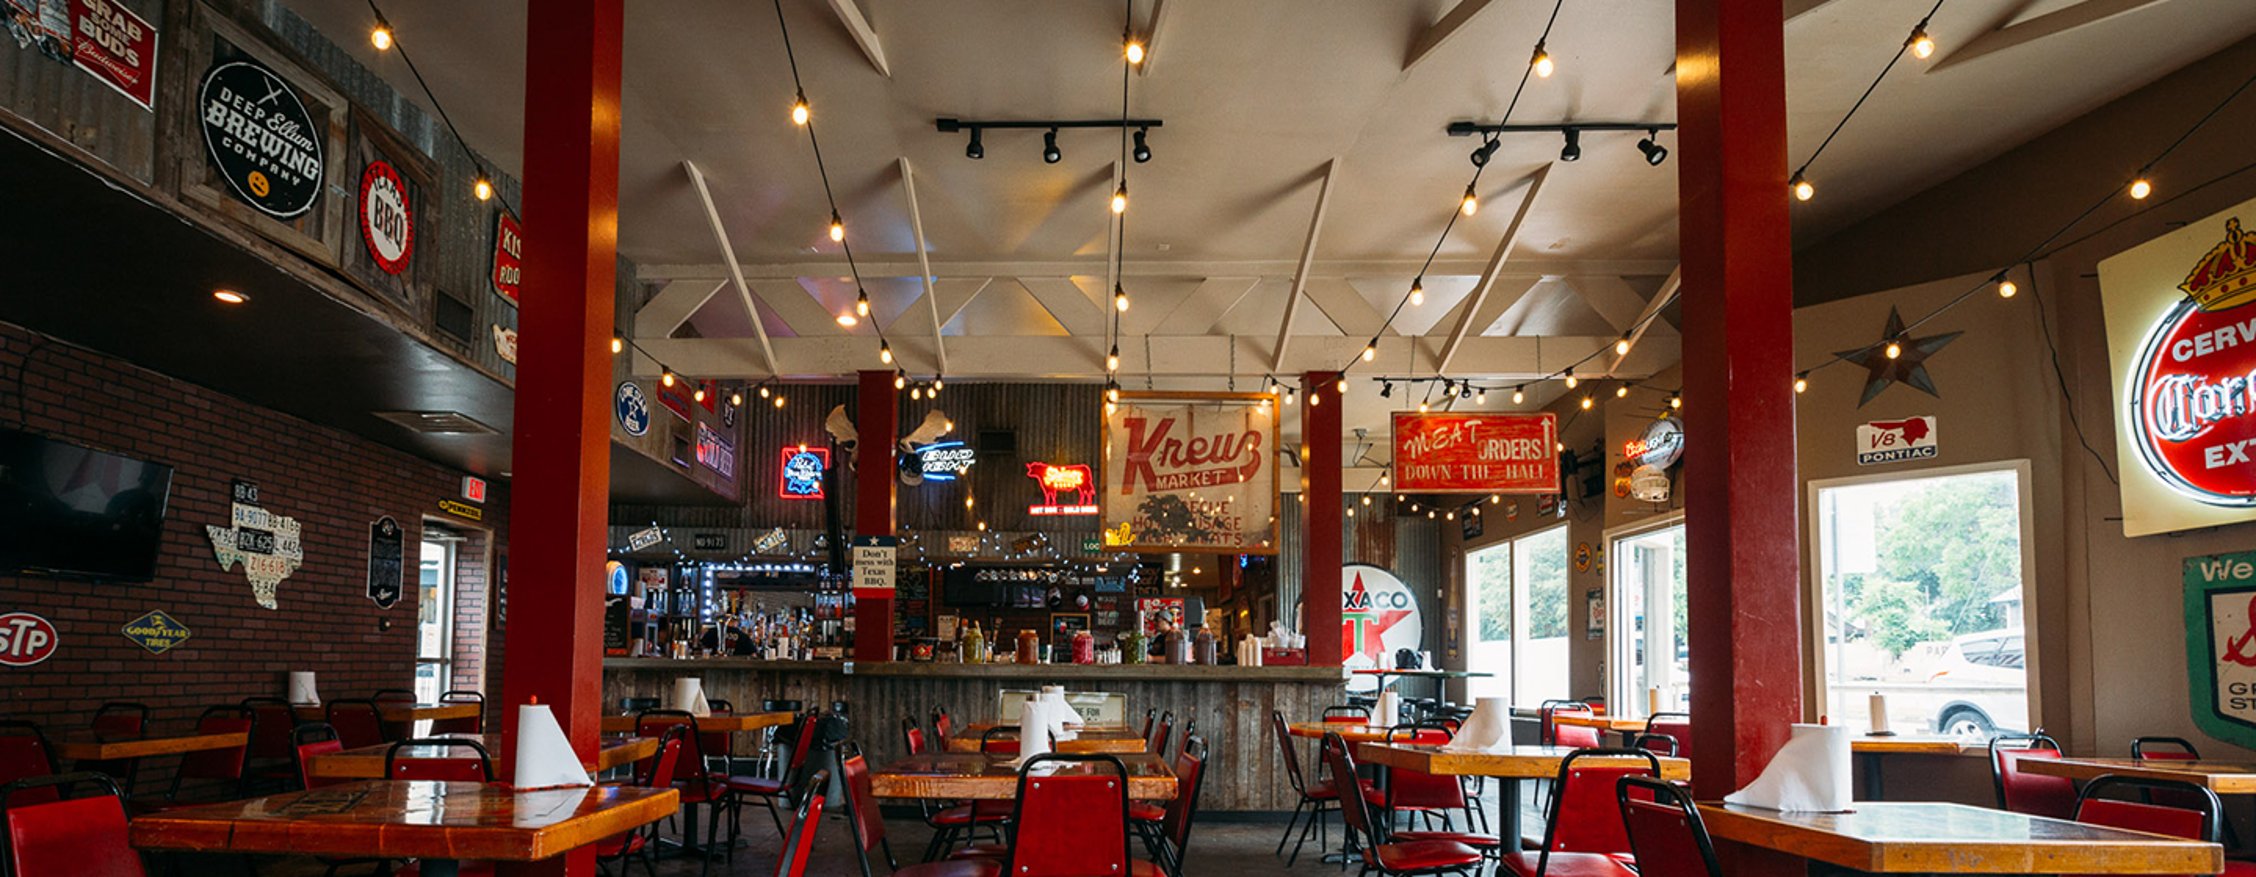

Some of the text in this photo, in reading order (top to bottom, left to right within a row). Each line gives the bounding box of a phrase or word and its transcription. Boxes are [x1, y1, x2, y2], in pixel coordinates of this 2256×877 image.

[83, 0, 142, 42] GRAB
[90, 12, 131, 46] SOME
[79, 14, 140, 67] BUDS
[76, 37, 138, 84] Budweiser
[220, 87, 314, 151] DEEP Ellum
[206, 99, 319, 181] BREWING
[222, 137, 300, 186] COMPANY
[374, 193, 404, 253] BBQ
[2172, 319, 2256, 362] CERV
[1121, 417, 1262, 495] Kreuz
[1404, 420, 1542, 461] MEAT ORDERS
[1863, 447, 1932, 462] PONTIAC
[1871, 431, 1896, 448] V8
[1155, 469, 1227, 490] MARKET
[1405, 464, 1548, 480] DOWN THE HALL
[863, 550, 887, 558] Don't
[2201, 559, 2254, 582] We
[863, 567, 886, 576] Texas
[864, 578, 887, 586] BBQ.
[0, 619, 48, 657] STP
[127, 626, 186, 638] GOODYEAR
[145, 638, 171, 648] TIRES
[2228, 682, 2256, 695] G
